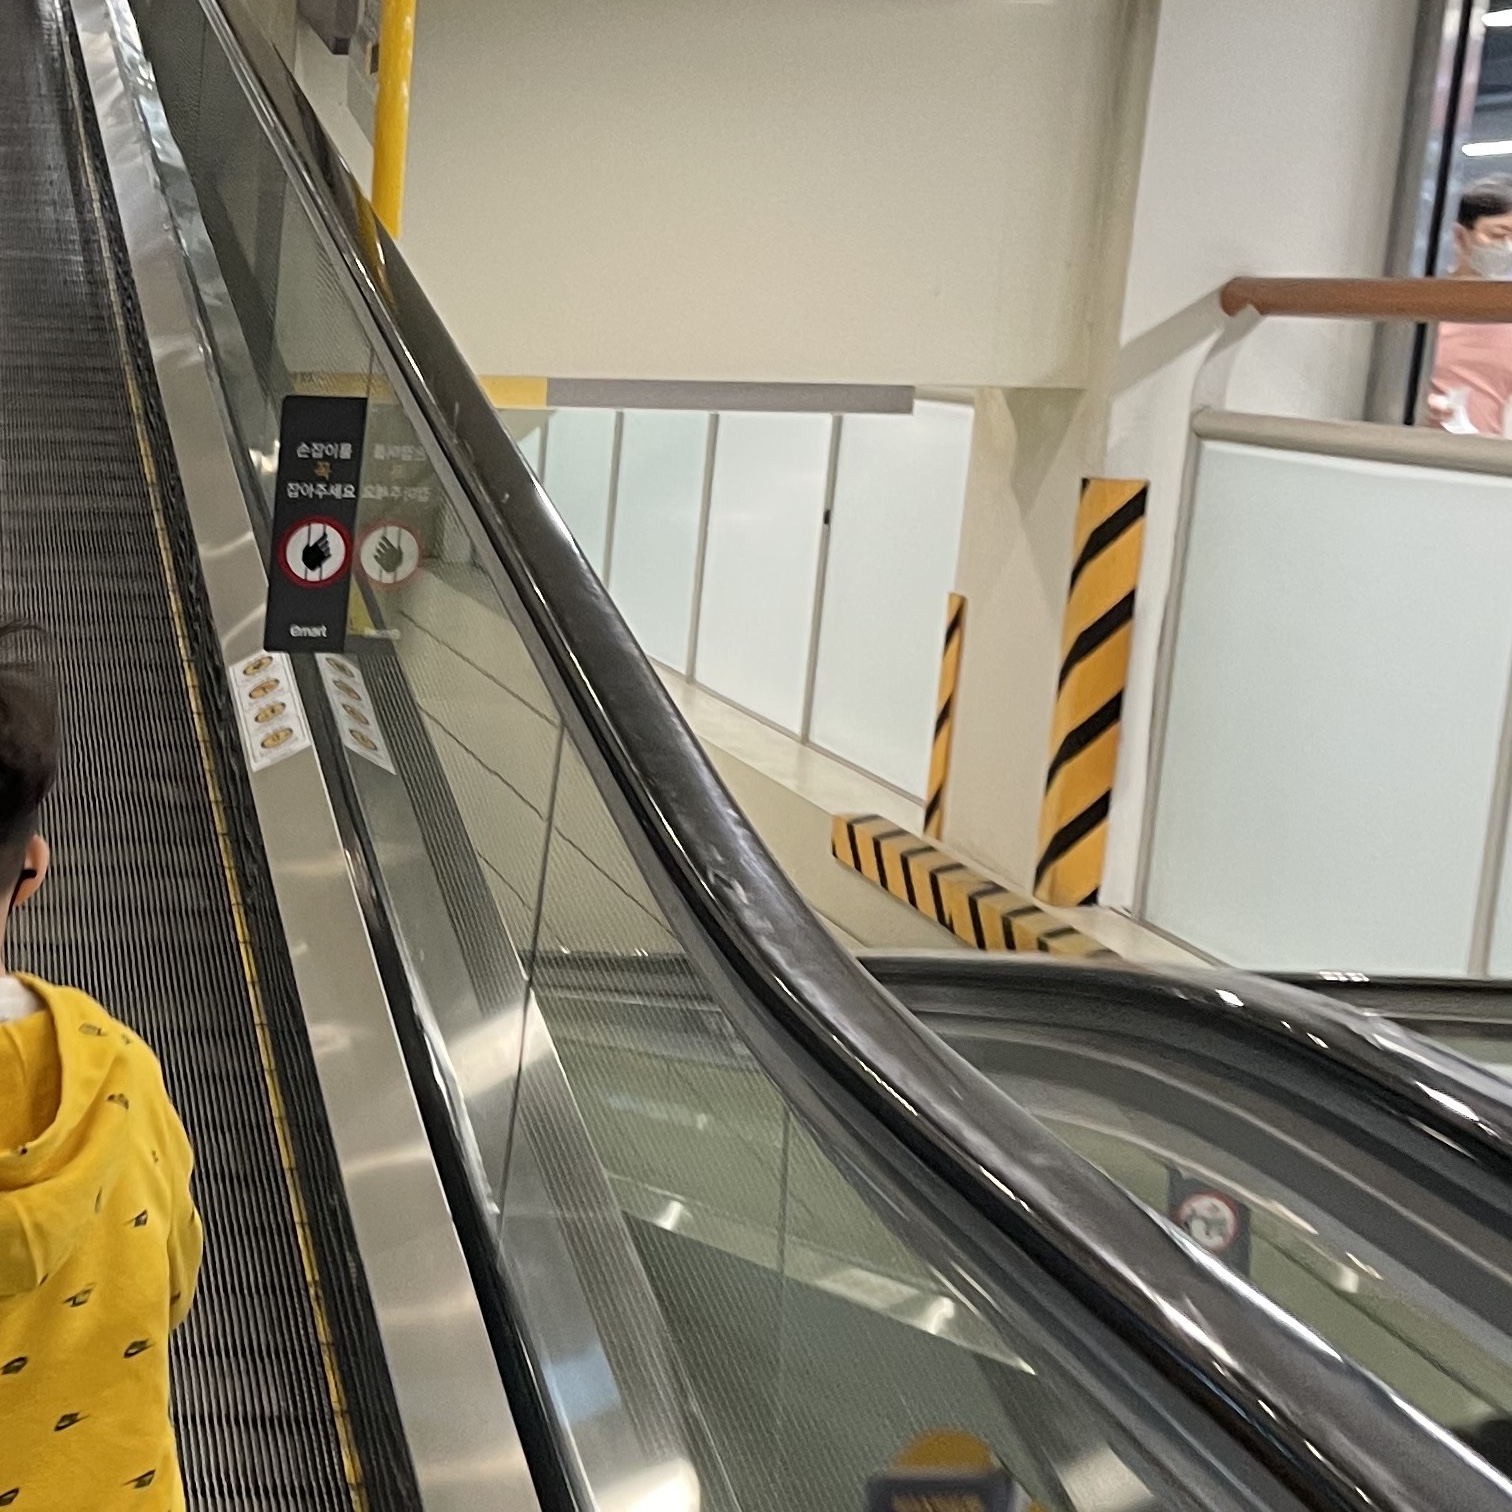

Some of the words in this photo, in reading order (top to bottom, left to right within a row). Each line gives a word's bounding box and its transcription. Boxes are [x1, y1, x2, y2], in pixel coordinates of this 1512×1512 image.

[296, 442, 352, 460] 손잡이를
[287, 482, 356, 499] 잡아주세요
[289, 624, 327, 638] emart
